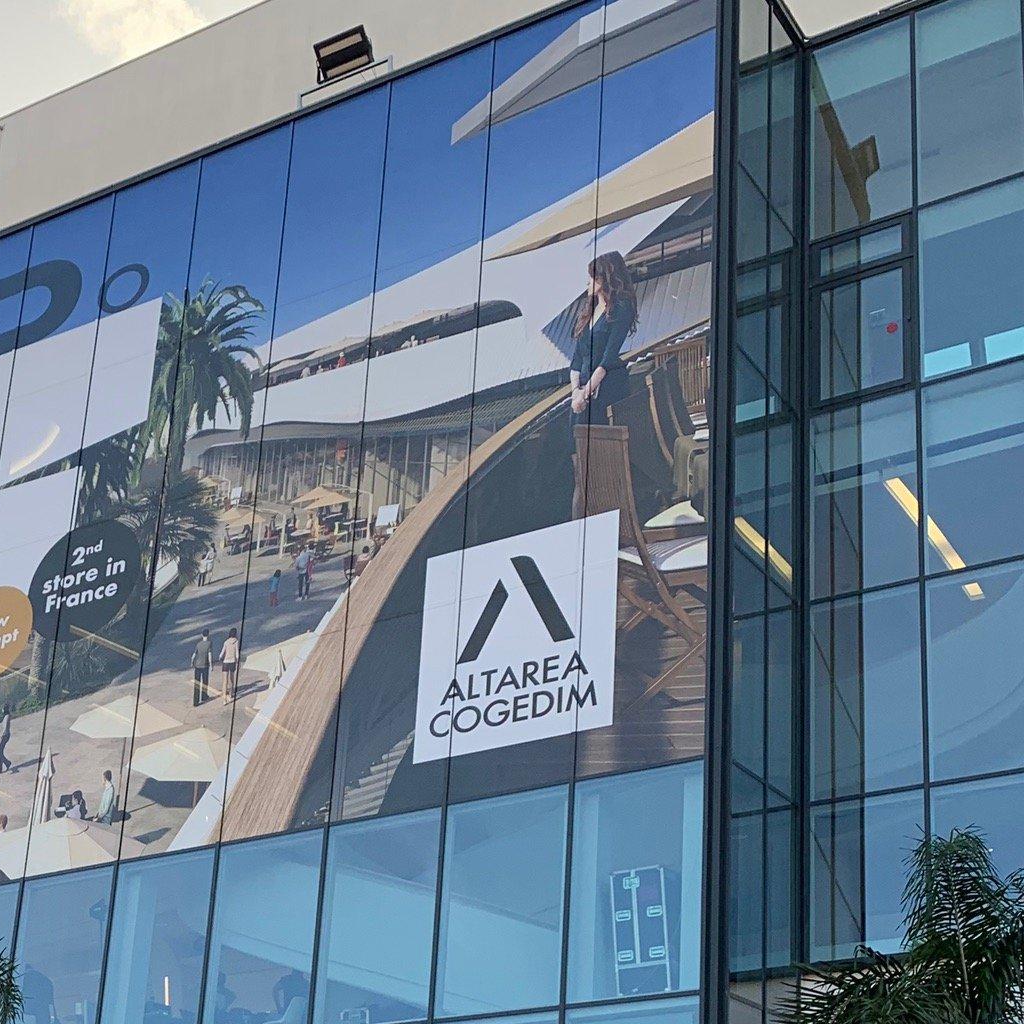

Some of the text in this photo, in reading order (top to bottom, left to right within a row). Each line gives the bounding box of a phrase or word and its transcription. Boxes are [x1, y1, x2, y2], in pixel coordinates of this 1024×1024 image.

[71, 539, 103, 567] 2nd
[42, 557, 126, 594] store in
[44, 582, 118, 613] France
[440, 650, 588, 706] ALTAREA
[429, 680, 597, 738] COGEDIM
